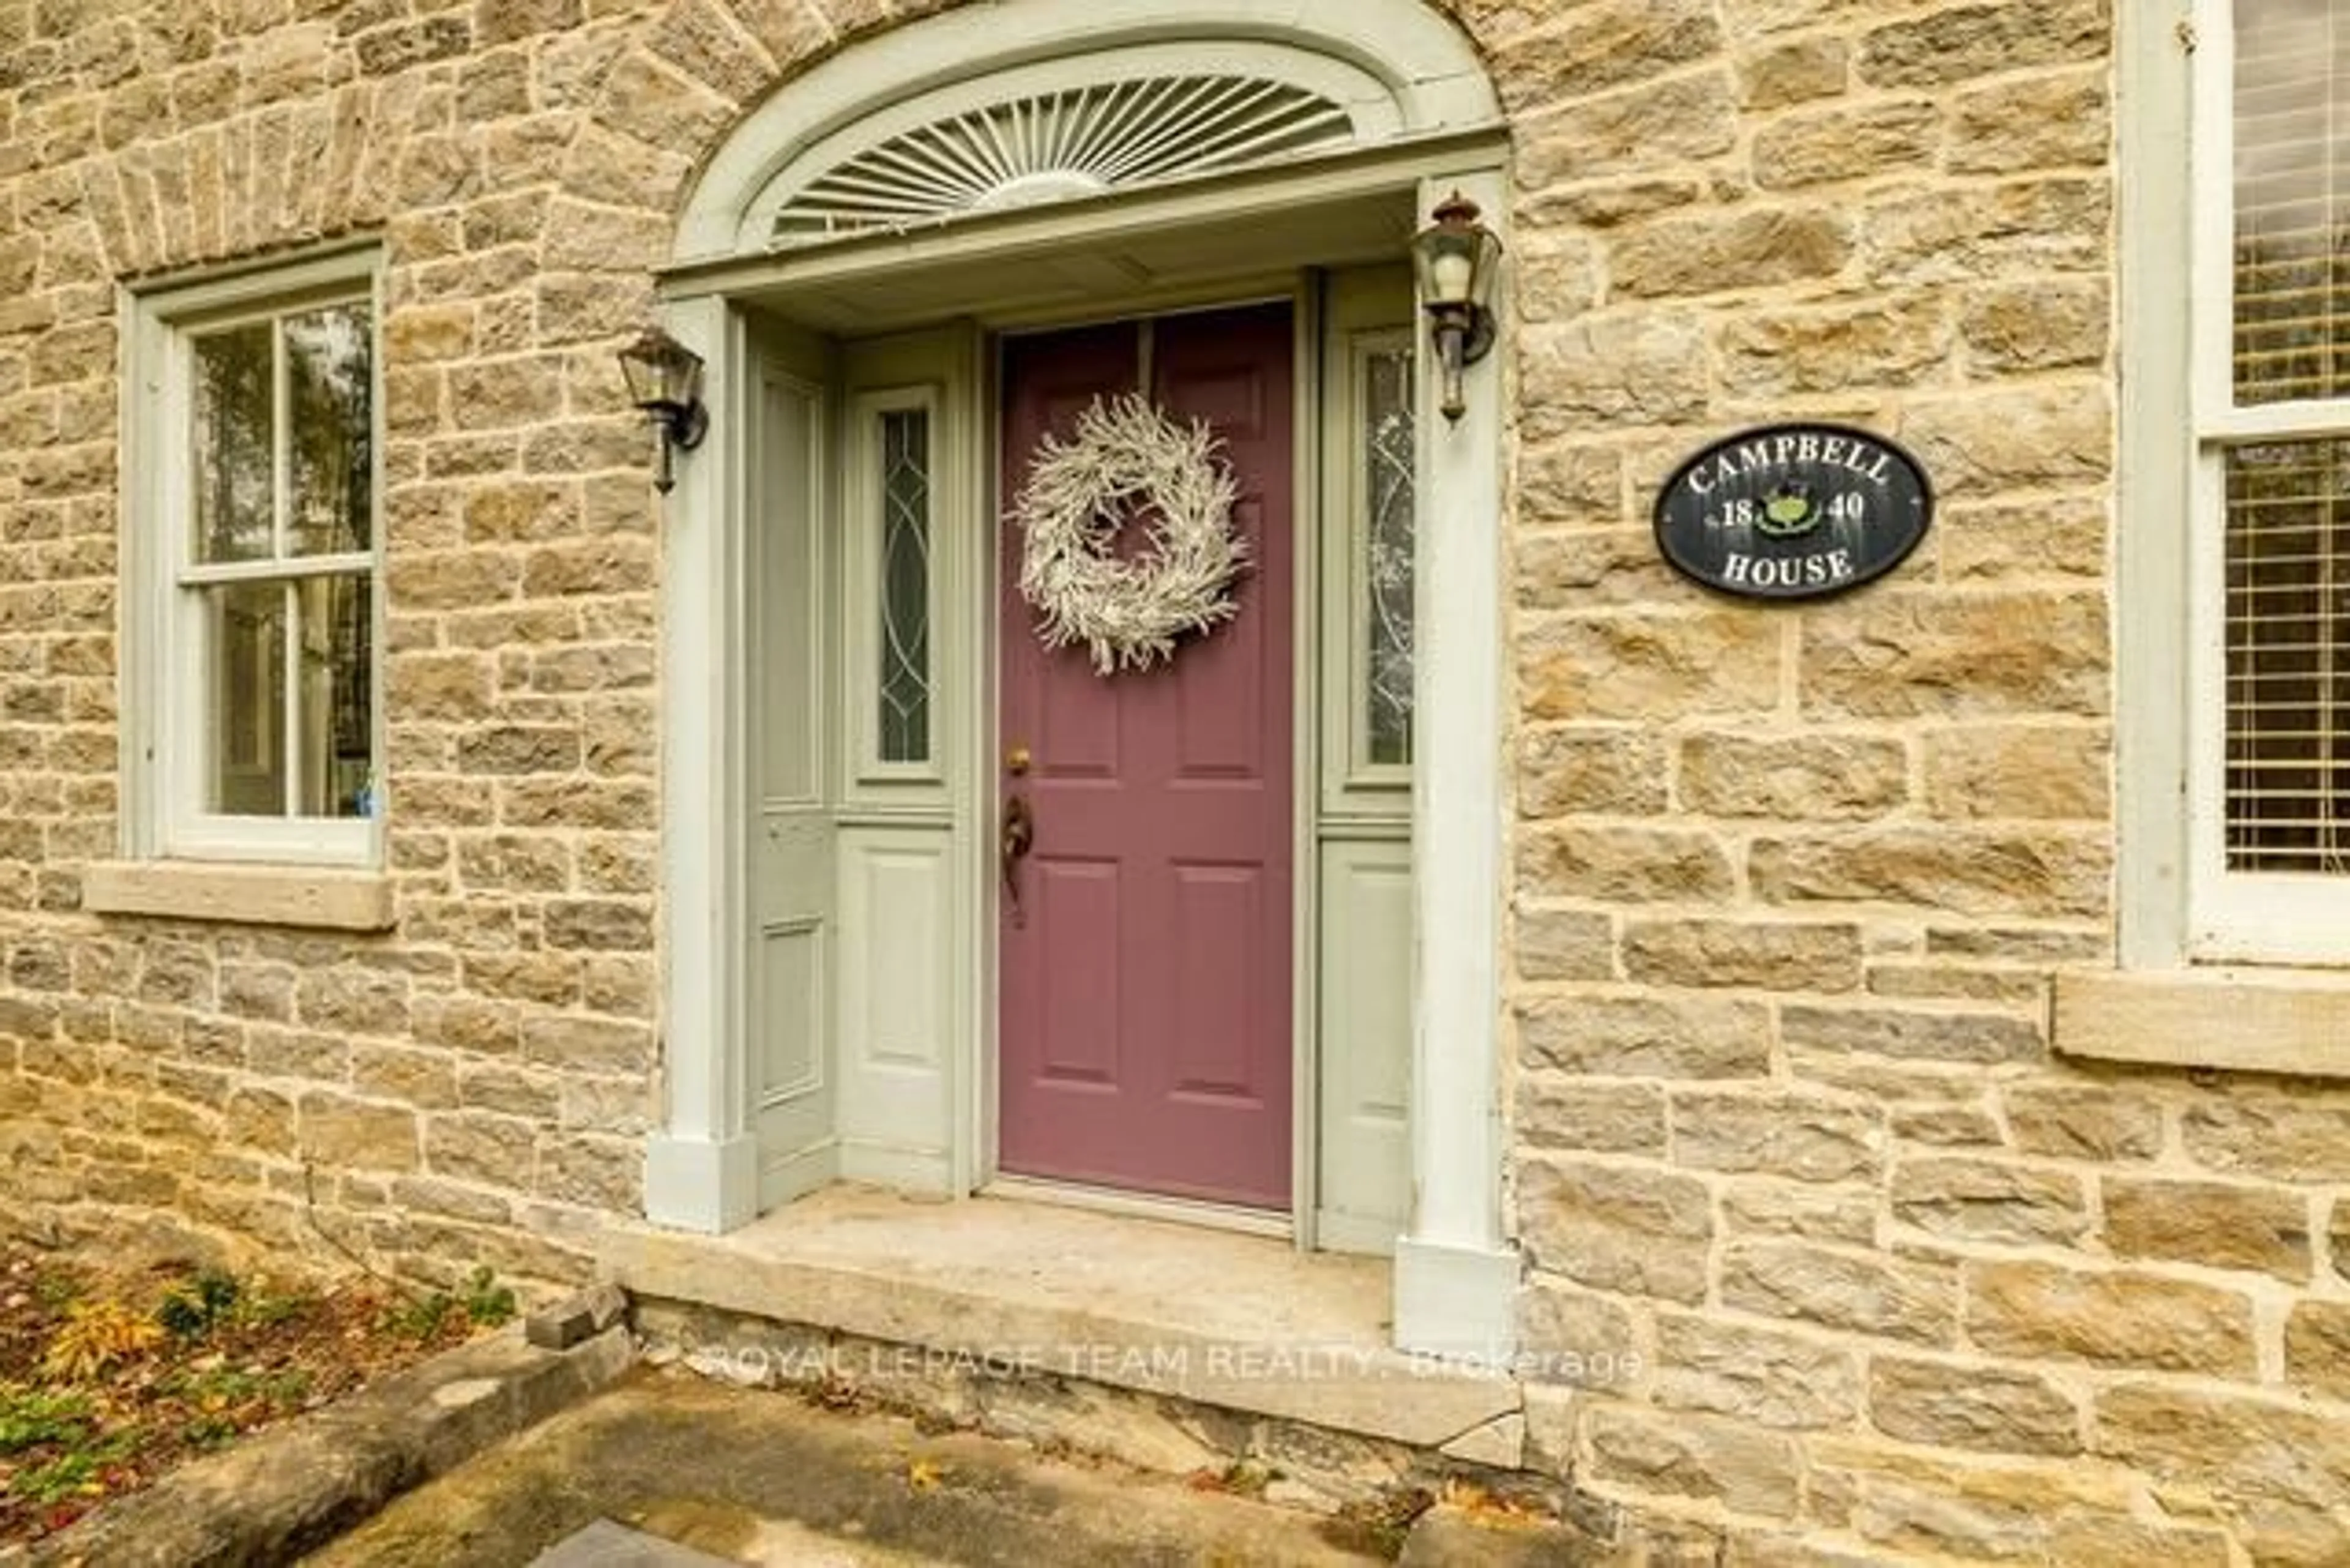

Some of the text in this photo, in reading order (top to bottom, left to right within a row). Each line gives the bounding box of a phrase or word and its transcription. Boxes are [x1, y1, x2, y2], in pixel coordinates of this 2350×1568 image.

[1688, 433, 1892, 495] CAMPBELL
[1722, 491, 1864, 527] 18 40
[1722, 550, 1853, 585] HOUSE
